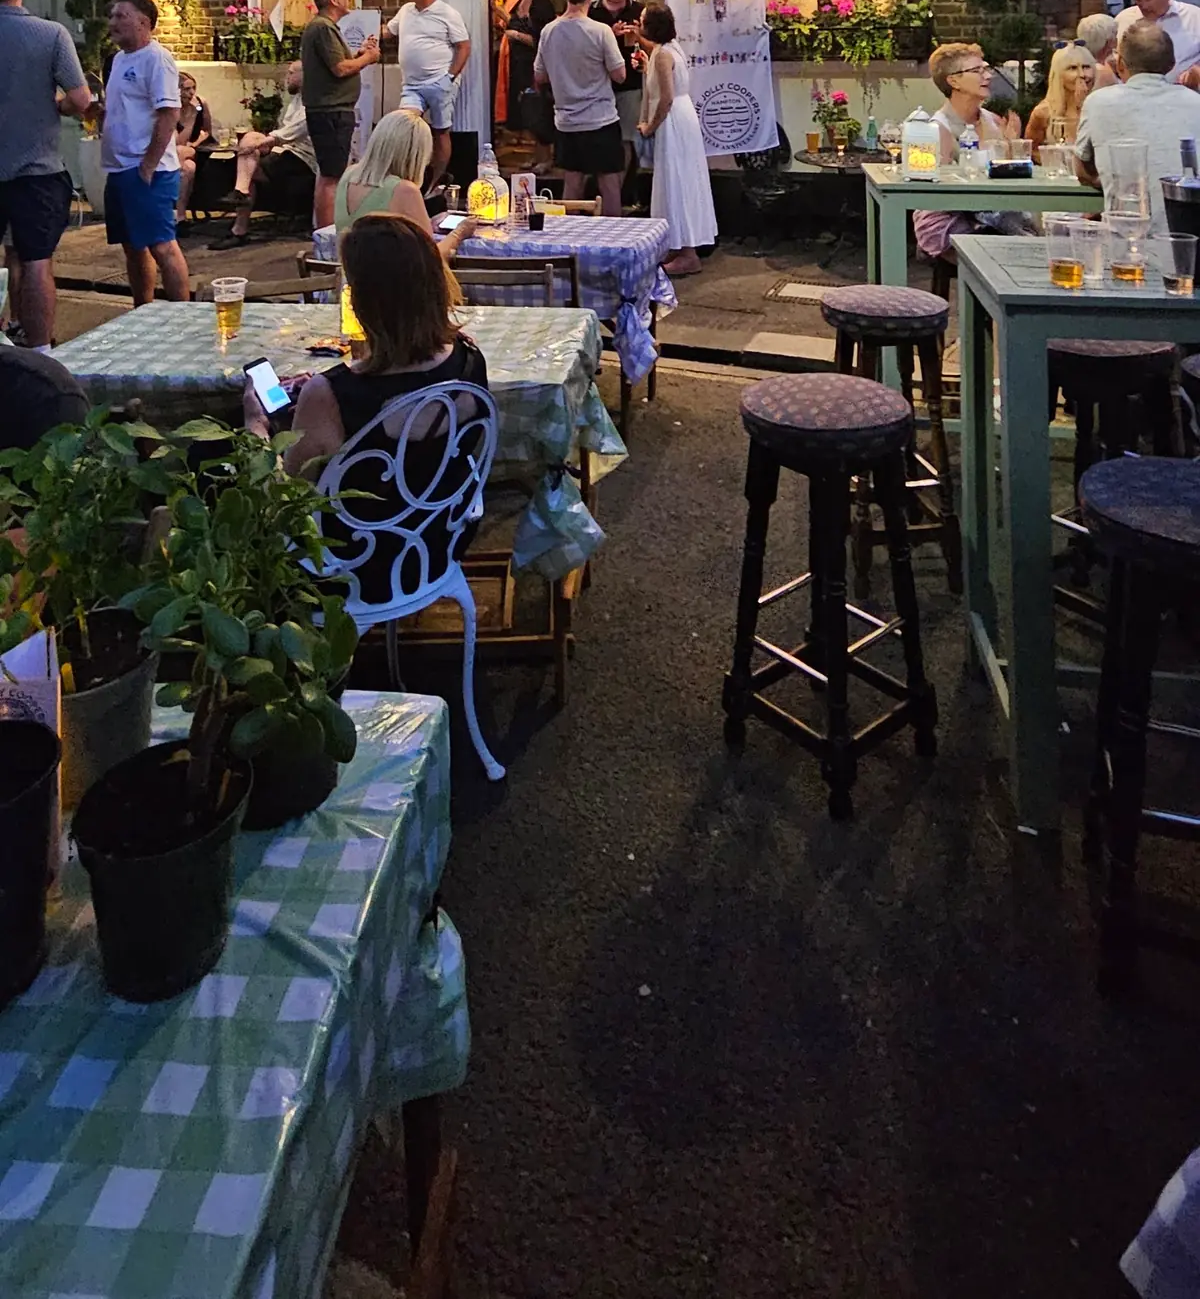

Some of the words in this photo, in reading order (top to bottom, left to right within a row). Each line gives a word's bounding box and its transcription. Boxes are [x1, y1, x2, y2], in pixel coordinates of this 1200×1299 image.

[694, 101, 704, 118] HE
[701, 83, 725, 101] JOLLY
[727, 82, 761, 115] COOPERS
